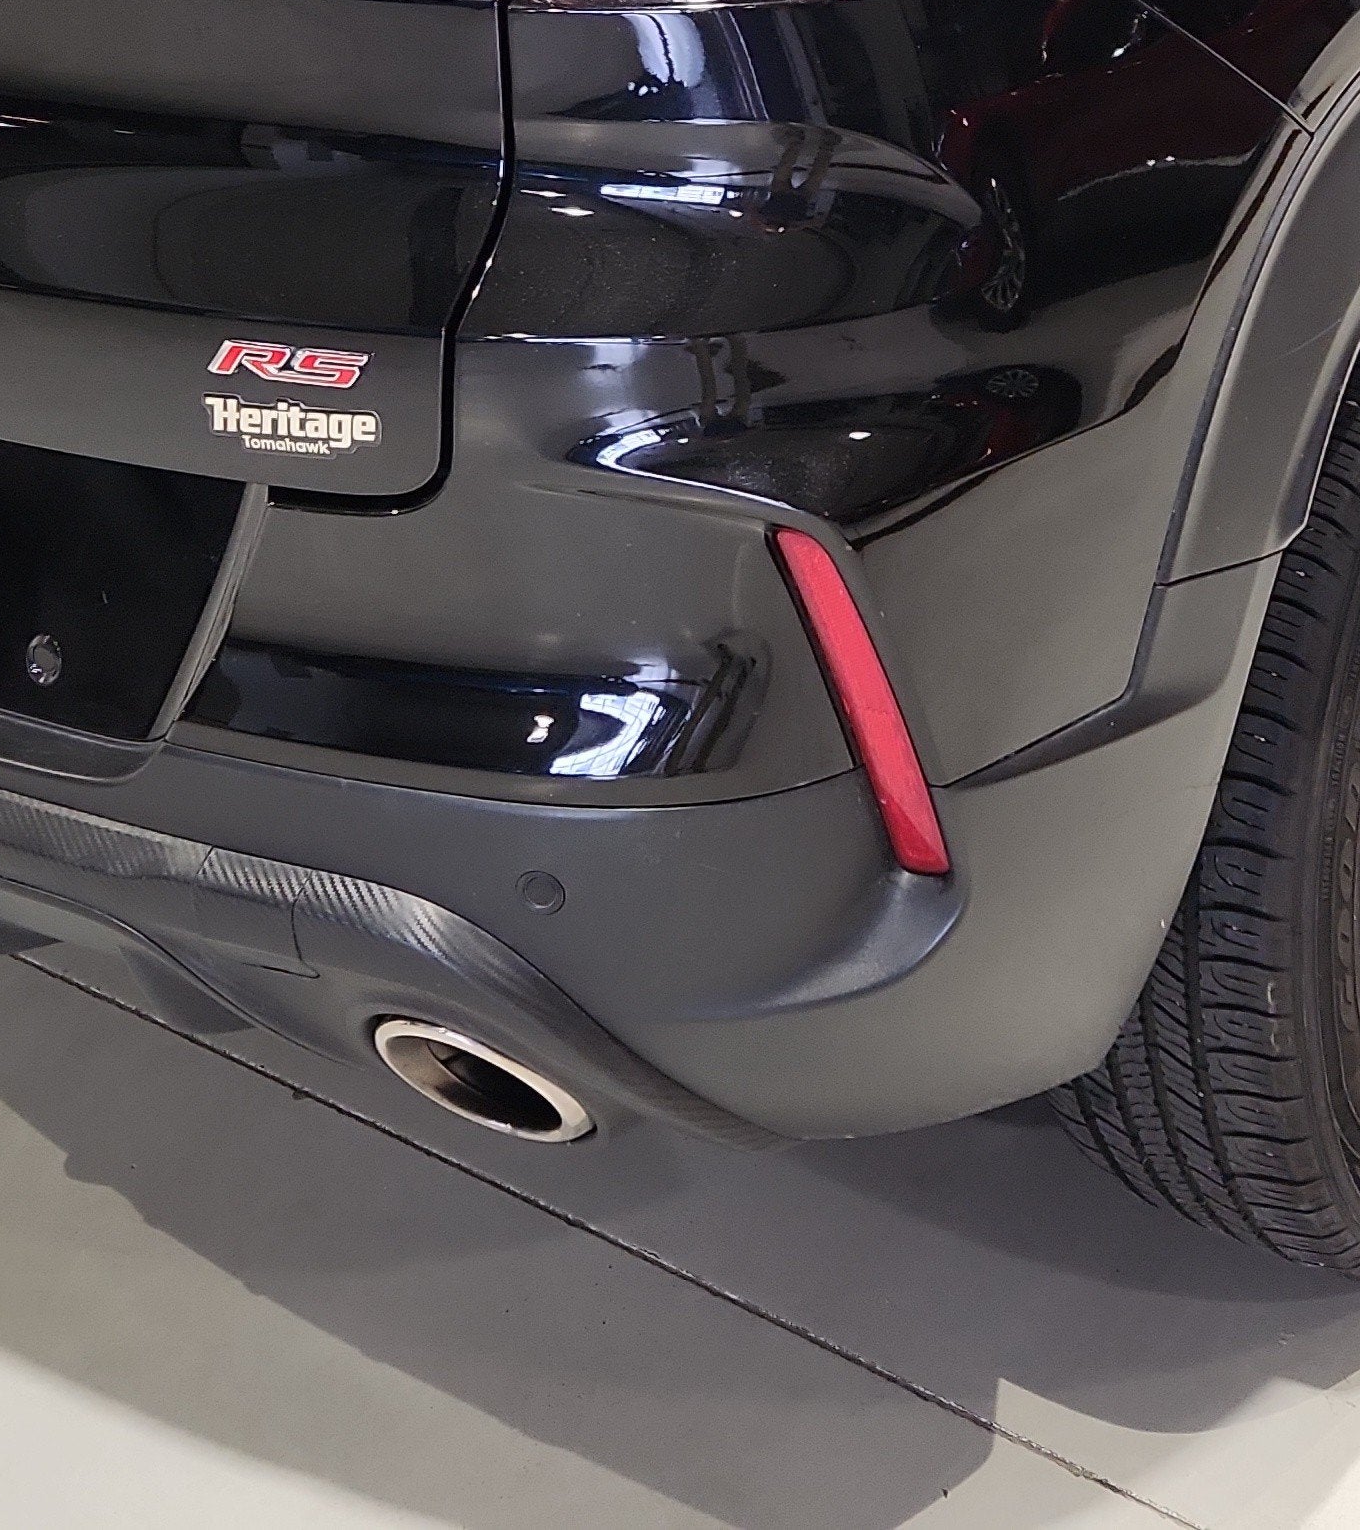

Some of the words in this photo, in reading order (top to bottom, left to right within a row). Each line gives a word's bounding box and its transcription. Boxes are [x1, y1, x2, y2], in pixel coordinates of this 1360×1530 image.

[207, 338, 375, 389] RS
[205, 396, 377, 449] Heritage
[242, 434, 331, 455] Tomahawk
